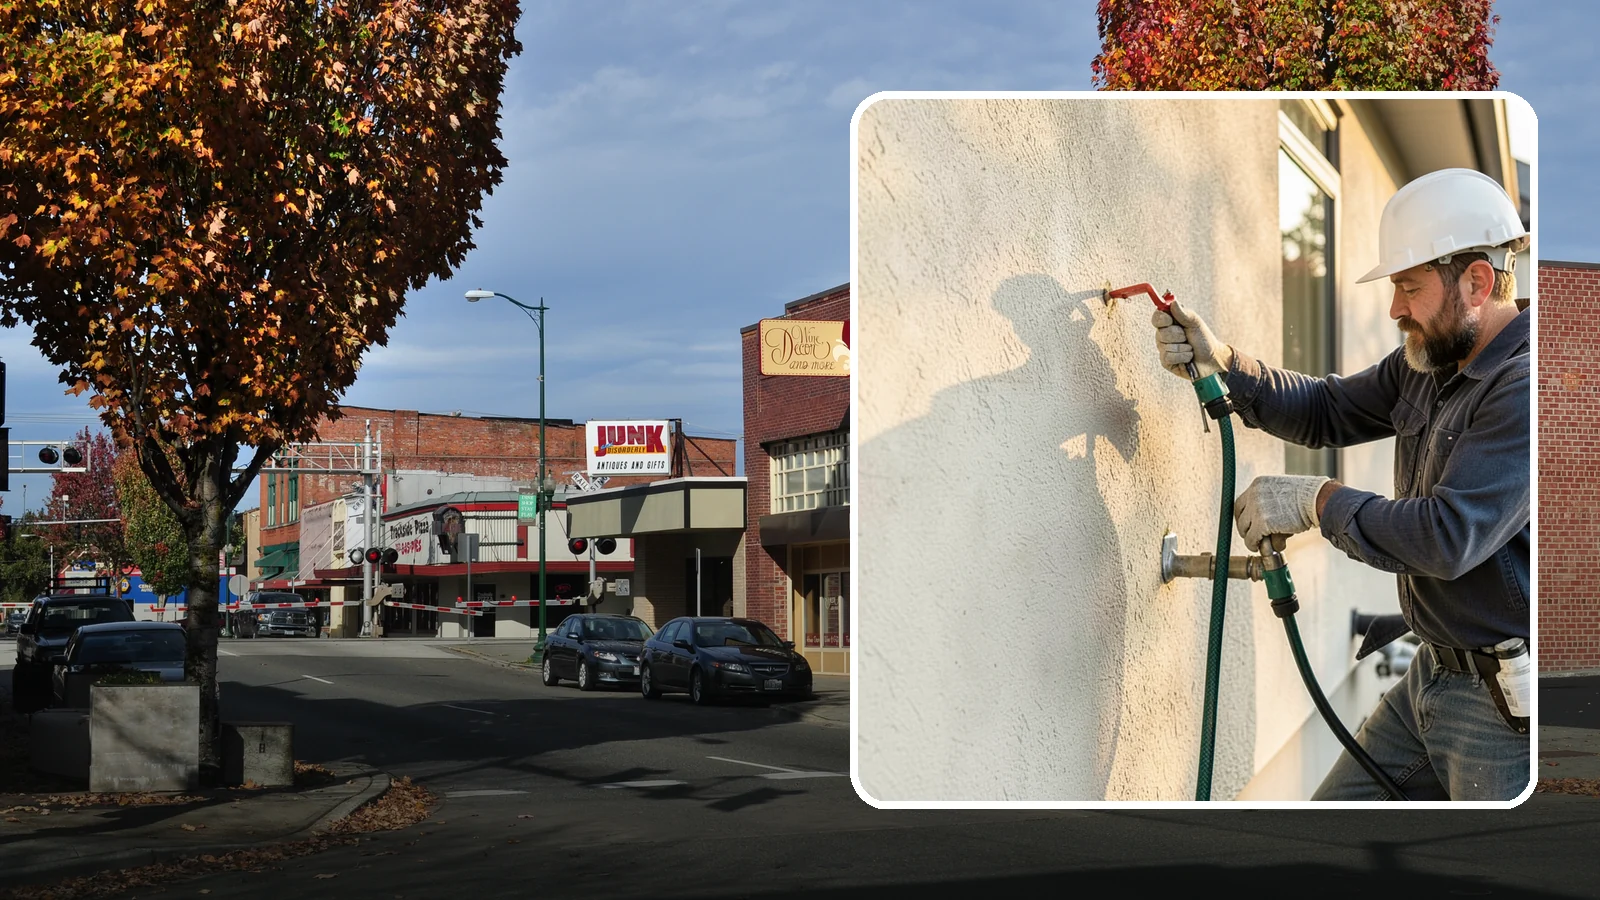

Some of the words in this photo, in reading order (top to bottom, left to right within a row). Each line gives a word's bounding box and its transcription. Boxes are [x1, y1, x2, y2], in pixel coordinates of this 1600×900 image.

[595, 425, 665, 457] JUNK
[607, 446, 645, 454] DISORDERLY
[597, 461, 628, 469] ANTIQUES
[631, 461, 643, 469] AND
[647, 461, 665, 469] GIFTS
[573, 473, 589, 492] RAIL
[390, 522, 413, 539] Trackside
[414, 519, 429, 535] Pizza
